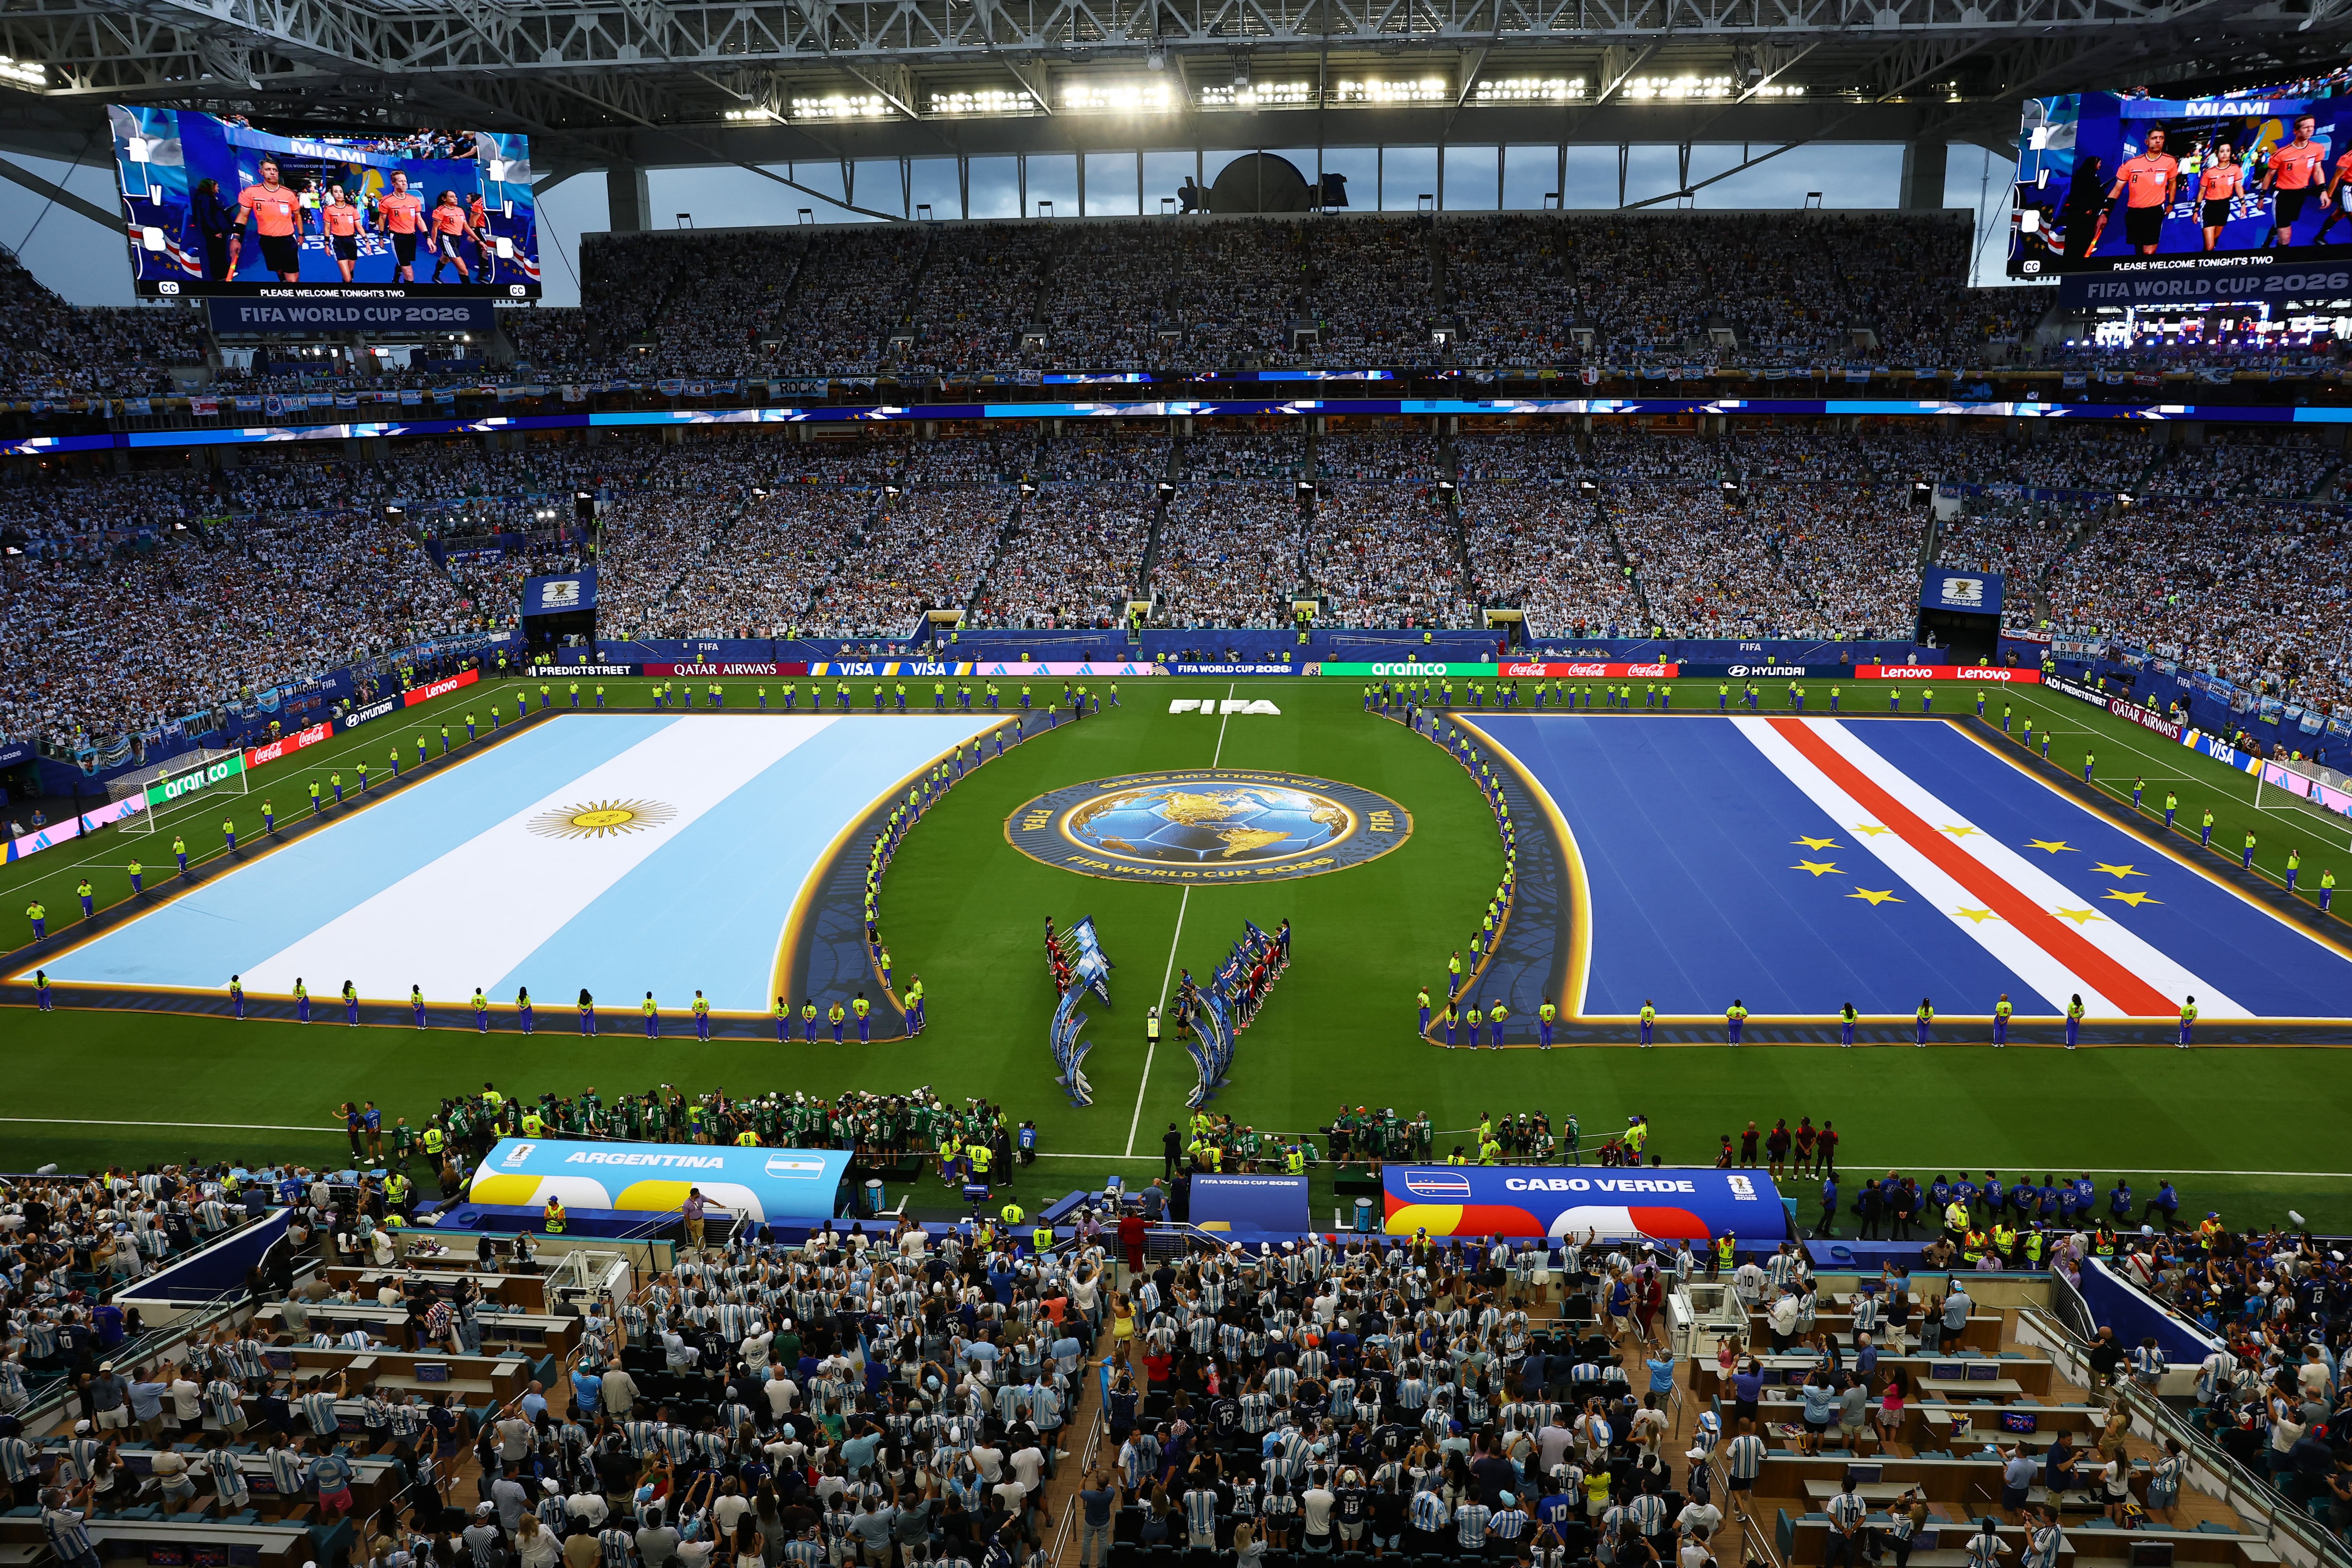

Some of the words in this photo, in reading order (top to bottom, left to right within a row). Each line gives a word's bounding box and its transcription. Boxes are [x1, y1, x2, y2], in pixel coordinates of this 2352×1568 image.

[2185, 102, 2270, 116] MIAMI
[291, 141, 367, 164] MIAMI
[2114, 262, 2147, 271] PLEASE
[2149, 258, 2196, 270] WELCOME
[2198, 256, 2249, 267] TONIGHT'S
[2249, 255, 2273, 264] TWO
[162, 284, 177, 292] CC
[511, 287, 523, 295] CC
[2088, 282, 2130, 298] FIFA
[2134, 279, 2211, 297] WORLD
[2215, 277, 2261, 294] CUP
[2264, 272, 2350, 292] 2026
[240, 307, 286, 322] FIFA
[287, 307, 360, 322] WORLD
[364, 307, 402, 322] CUP
[405, 307, 470, 322] 2026
[779, 382, 817, 394] ROCK
[437, 632, 490, 646] REPUBLICA
[2056, 634, 2095, 644] LOMAS
[439, 645, 452, 654] DE
[454, 643, 466, 652] LA
[467, 639, 492, 652] BOCA
[699, 643, 719, 651] FIFA
[1740, 643, 1761, 652] FIFA
[2053, 651, 2096, 661] ZAMORA
[540, 666, 631, 676] PREDICTSTREET
[674, 663, 719, 677] QATAR
[723, 663, 777, 675] AIRWAYS
[837, 663, 874, 676] VISA
[908, 663, 946, 676] VISA
[1178, 665, 1198, 674] FIFA
[1200, 665, 1233, 674] WORLD
[1235, 665, 1255, 674] CUP
[1255, 665, 1288, 674] 2026
[1372, 662, 1447, 676] aramco
[1508, 663, 1549, 677] Coca-Cola
[1568, 663, 1605, 677] Coca-Cola
[1628, 663, 1665, 677] Coca-Cola
[1752, 667, 1805, 676] HYUNDAI
[1881, 667, 1932, 678] Lenovo
[1957, 667, 2011, 680] Lenovo
[322, 679, 337, 691] FIFA
[425, 679, 458, 698] Lenovo
[2177, 676, 2190, 689] FIFA
[2212, 678, 2223, 689] LOMAS
[2045, 676, 2060, 690] ADI
[2060, 682, 2107, 707] PREDICTSTREET
[2210, 686, 2227, 697] ZAMORA
[360, 701, 393, 722] HYUNDAI
[1168, 699, 1281, 715] FIFA
[183, 713, 214, 739] PUAN
[2112, 700, 2139, 724] QATAR
[2142, 712, 2178, 739] AIRWAYS
[299, 725, 324, 748] Coca-Cola
[3, 750, 22, 761] 2026
[2209, 739, 2234, 766] VISA
[165, 763, 228, 798] aramco
[1099, 775, 1168, 789] 2026
[1215, 773, 1287, 782] WORLD
[1290, 778, 1329, 789] FIFA
[1022, 809, 1054, 831] FIFA
[1368, 810, 1395, 832] FIFA
[1065, 855, 1110, 870] FIFA
[1113, 865, 1198, 878] WORLD
[1202, 870, 1251, 878] CUP
[1256, 857, 1336, 875] 2026
[564, 1151, 724, 1169] ARGENTINA
[1505, 1178, 1590, 1191] CABO
[1594, 1179, 1696, 1193] VERDE
[116, 1242, 126, 1252] 10
[898, 1265, 908, 1276] 10
[1523, 1260, 1532, 1270] 10
[1226, 1280, 1238, 1292] 10
[1744, 1275, 1754, 1288] 10
[2313, 1291, 2323, 1304] 13
[436, 1312, 446, 1326] 19
[625, 1315, 636, 1325] 10
[947, 1324, 960, 1336] 19
[59, 1336, 72, 1349] 10
[706, 1342, 717, 1354] 11
[241, 1349, 253, 1362] 10
[831, 1366, 842, 1374] 10
[211, 1393, 223, 1406] 10
[813, 1389, 822, 1399] 10
[1342, 1390, 1349, 1402] 8
[1250, 1405, 1263, 1417] 10
[1220, 1411, 1233, 1426] 19
[2256, 1414, 2266, 1429] 10
[1384, 1436, 1397, 1447] 10
[213, 1462, 227, 1477] 10
[1559, 1477, 1574, 1489] 10
[1237, 1495, 1253, 1512] 24
[1343, 1501, 1358, 1514] 10
[1418, 1498, 1432, 1519] 11
[546, 1507, 561, 1525] 10
[1550, 1504, 1567, 1523] 10
[828, 1525, 844, 1537] 10
[605, 1543, 620, 1560] 10
[987, 1545, 999, 1560] PAREDES
